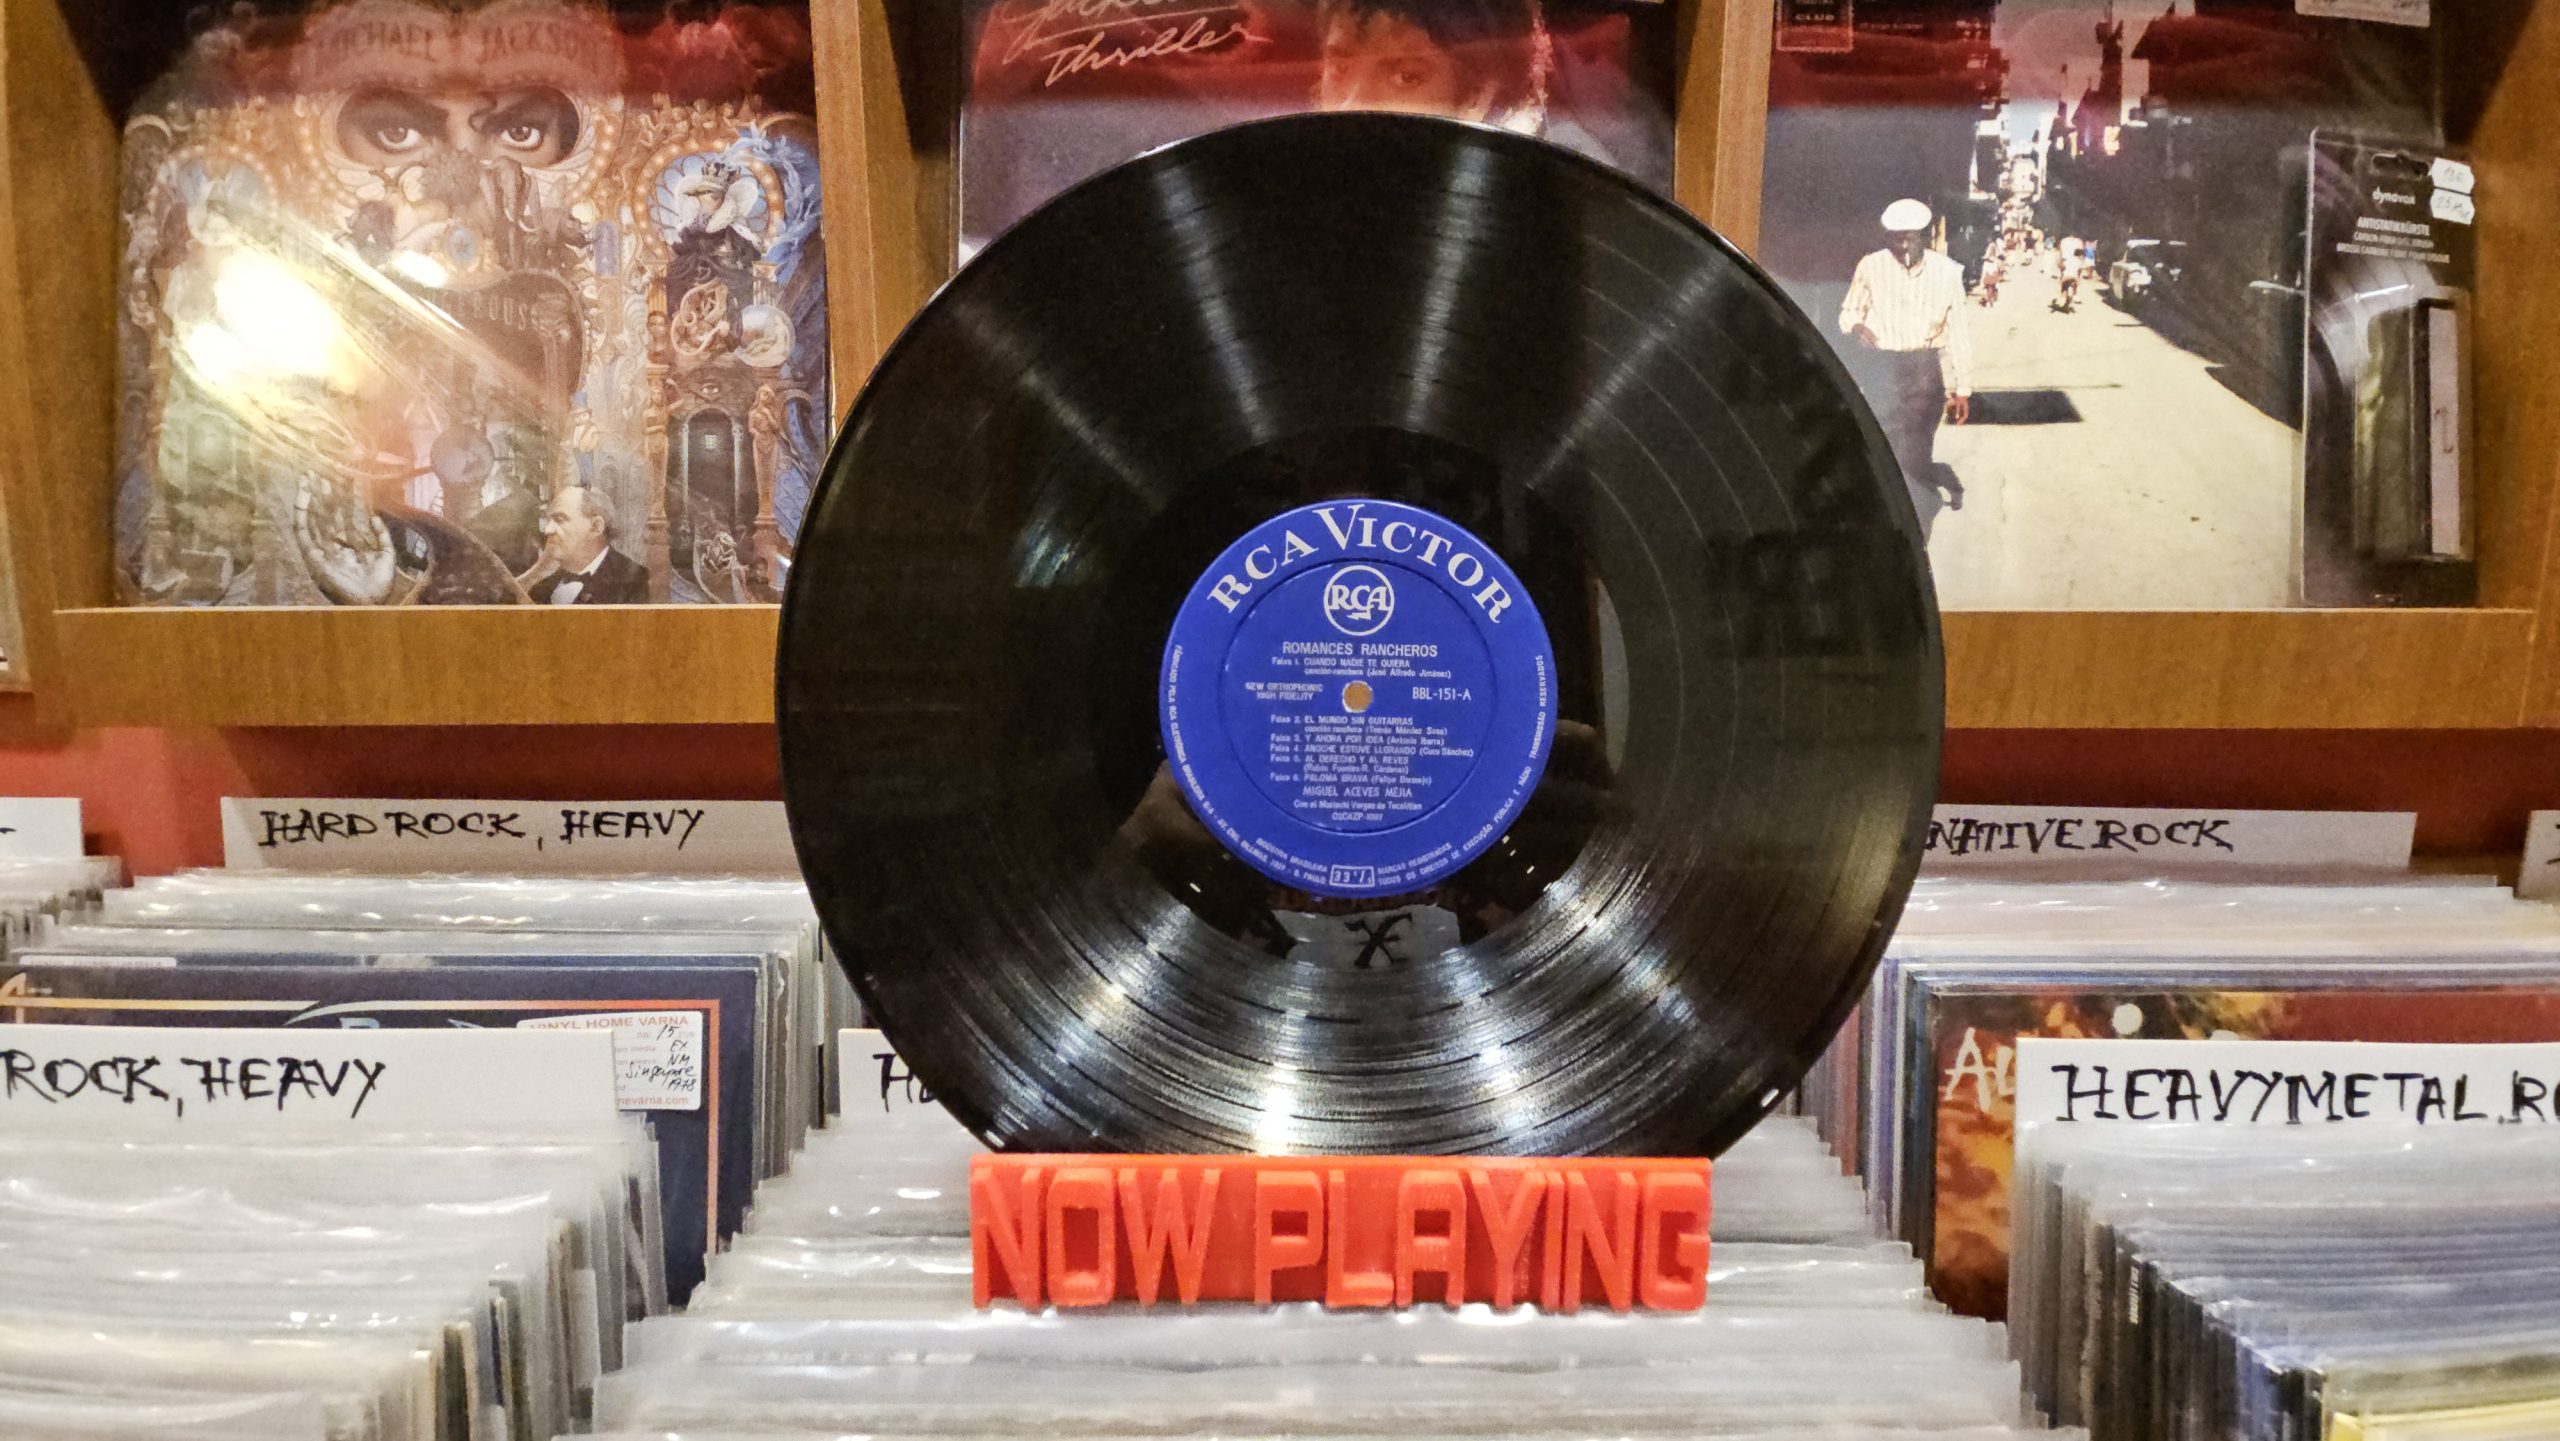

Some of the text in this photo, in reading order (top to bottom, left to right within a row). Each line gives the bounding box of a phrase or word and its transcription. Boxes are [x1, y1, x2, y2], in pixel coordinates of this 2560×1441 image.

[1040, 16, 1274, 88] Thriller
[1206, 529, 1319, 614] RCA
[1330, 584, 1391, 612] RCA
[1282, 641, 1438, 657] ROMANCES RANCHEROS
[1304, 658, 1337, 667] CUANDO
[1368, 659, 1377, 667] TE
[1535, 654, 1548, 707] RESERVADOS
[1279, 691, 1314, 701] FIDELITY
[1412, 686, 1472, 701] BBL-151-A
[1304, 716, 1315, 724] EL
[1318, 716, 1348, 725] MUNDO
[1315, 735, 1342, 744] AHORA
[1345, 735, 1362, 744] POR
[1305, 755, 1315, 763] AL
[1319, 756, 1356, 765] DERECHO
[1369, 756, 1379, 764] AL
[1304, 773, 1337, 783] PALOMA
[1341, 773, 1369, 783] BRAVA
[1303, 786, 1338, 797] MIGUEL
[1344, 786, 1380, 797] ACEVES
[259, 809, 378, 847] HARD
[559, 808, 705, 851] HEAVY
[2090, 819, 2234, 852] ROCK
[586, 1016, 633, 1029] HOME
[638, 1015, 689, 1027] VARNA
[180, 1056, 386, 1119] HEAVY
[970, 1167, 1711, 1317] NOW PLAYING
